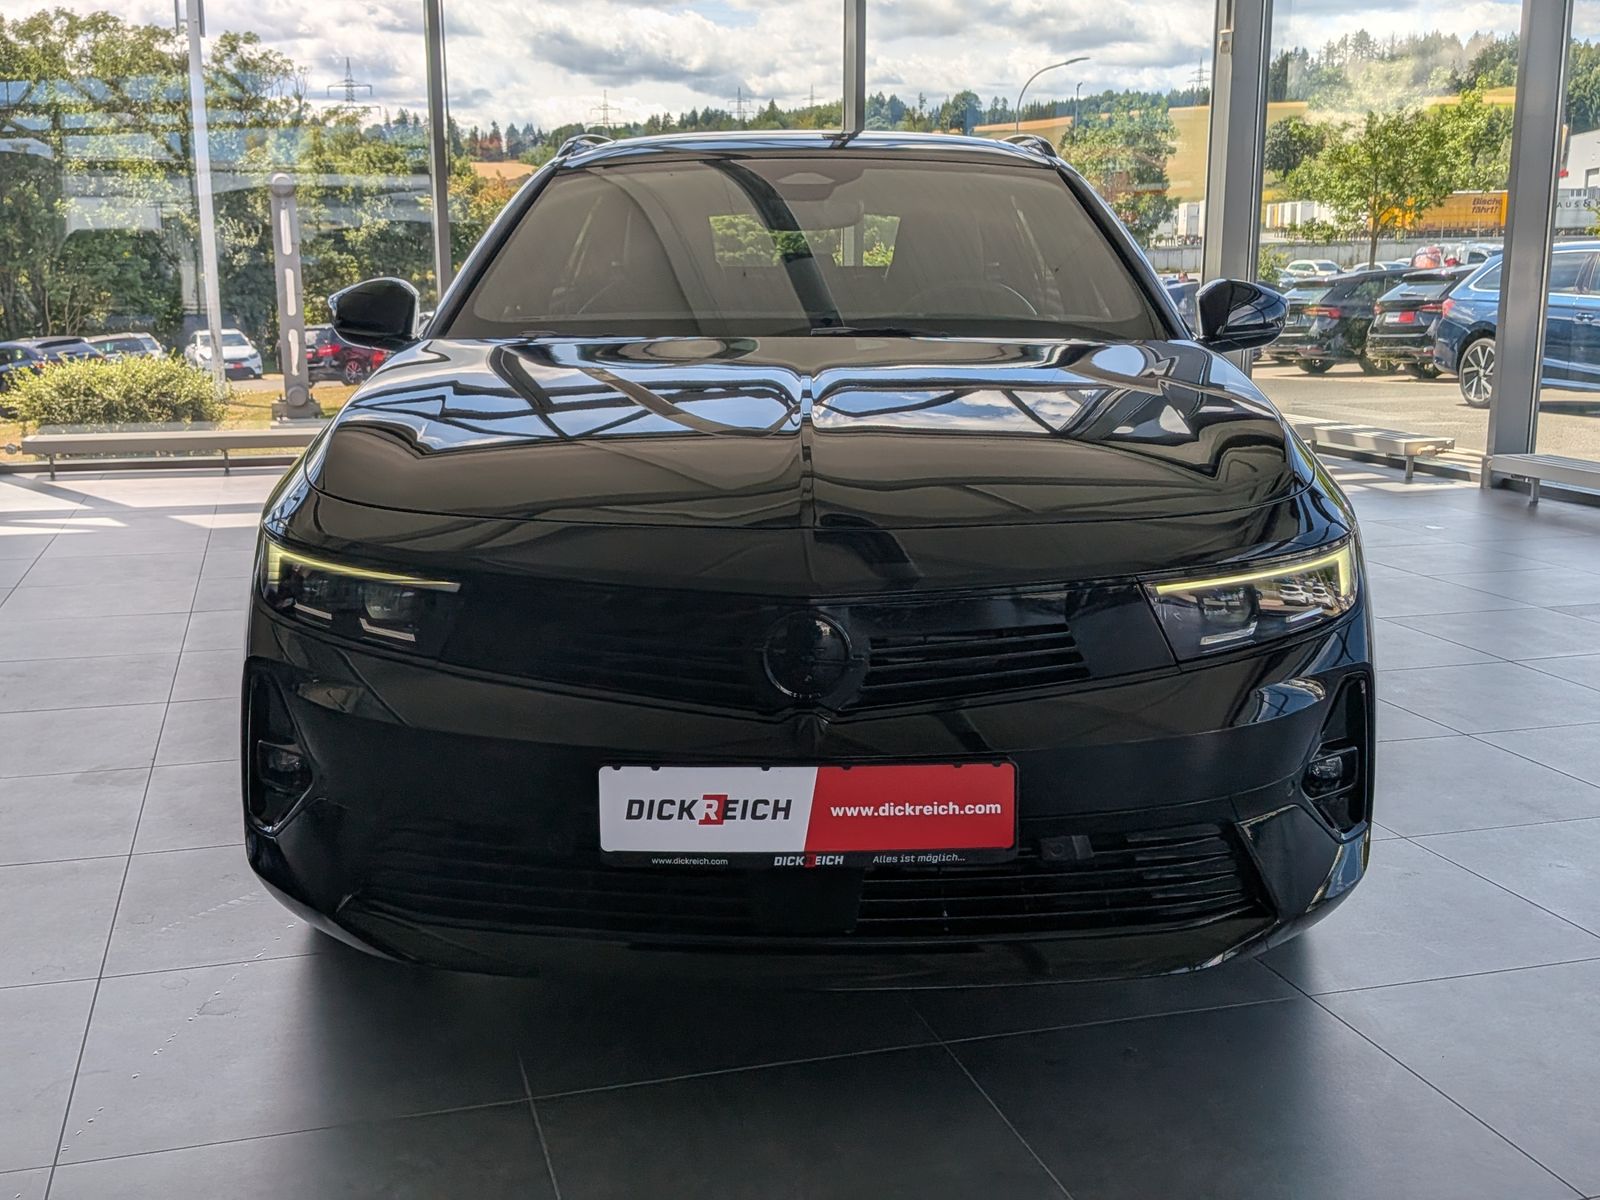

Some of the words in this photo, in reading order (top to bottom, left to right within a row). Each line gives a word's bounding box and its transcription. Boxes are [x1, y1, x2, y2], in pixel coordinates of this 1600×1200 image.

[625, 794, 792, 825] DICKREICH
[830, 802, 1001, 816] www.dickreich.com
[651, 856, 728, 865] www.dickreich.com
[774, 854, 844, 867] DICKEICH
[872, 855, 898, 864] Alles
[900, 855, 916, 863] ist
[917, 853, 966, 864] möglich...
